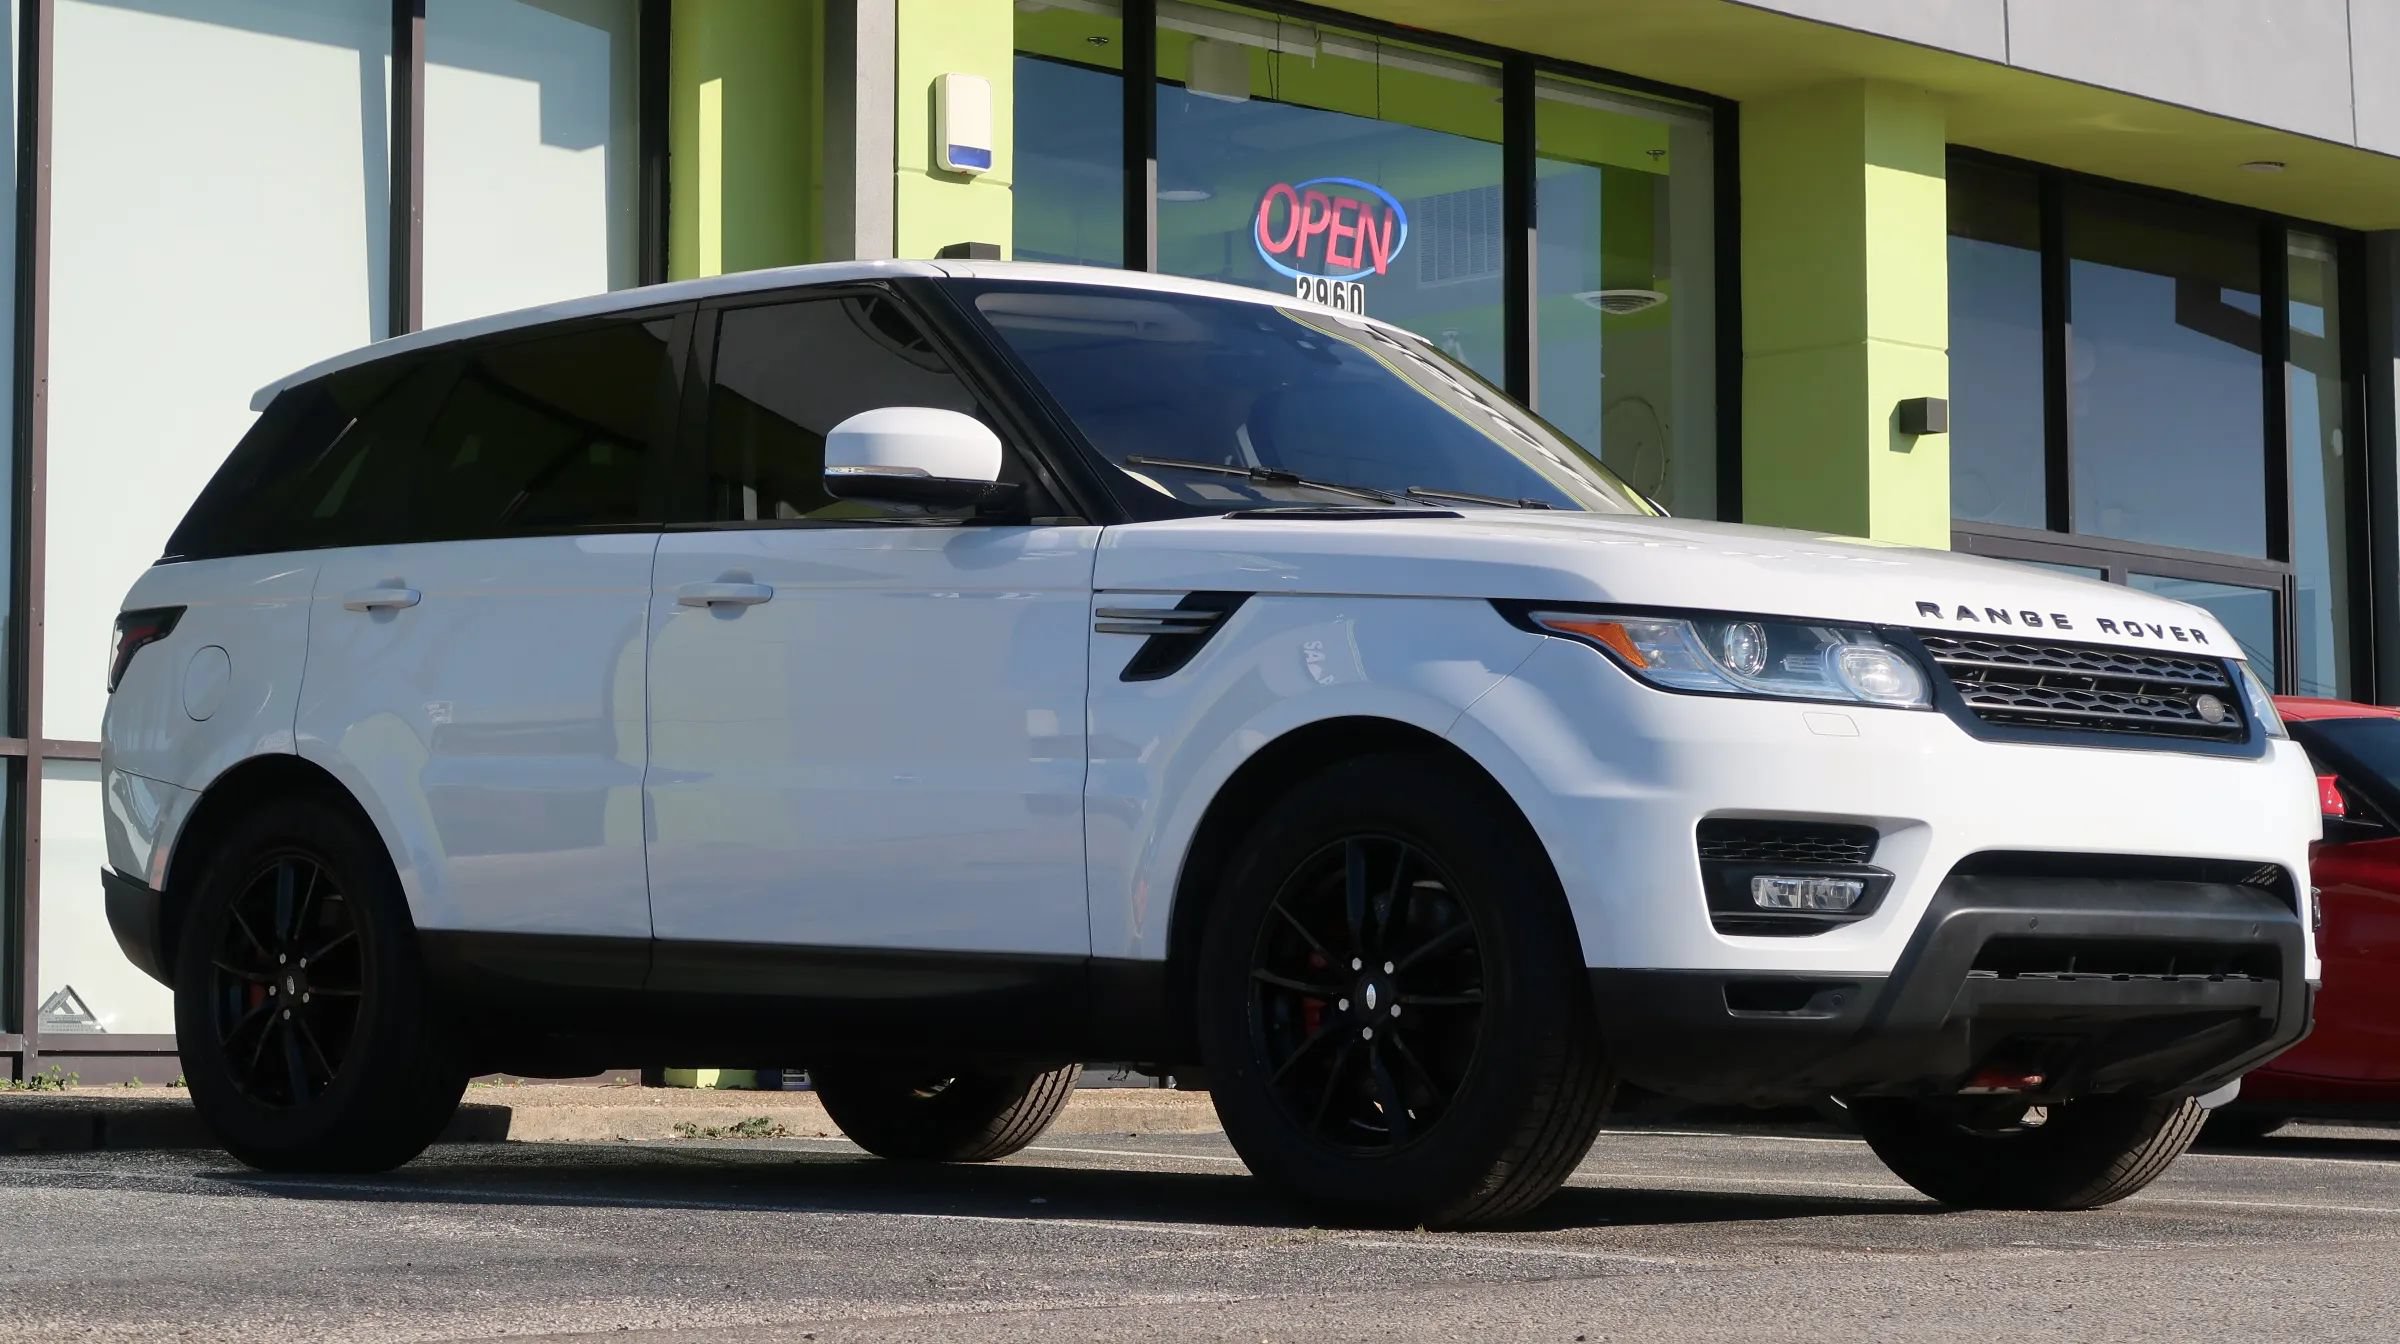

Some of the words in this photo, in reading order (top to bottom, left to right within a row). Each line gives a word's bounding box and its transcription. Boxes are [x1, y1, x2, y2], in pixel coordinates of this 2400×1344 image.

[1258, 182, 1393, 276] OPEN
[1299, 276, 1362, 315] 2960
[1915, 600, 2074, 631] RANGE
[2096, 617, 2210, 645] ROVER
